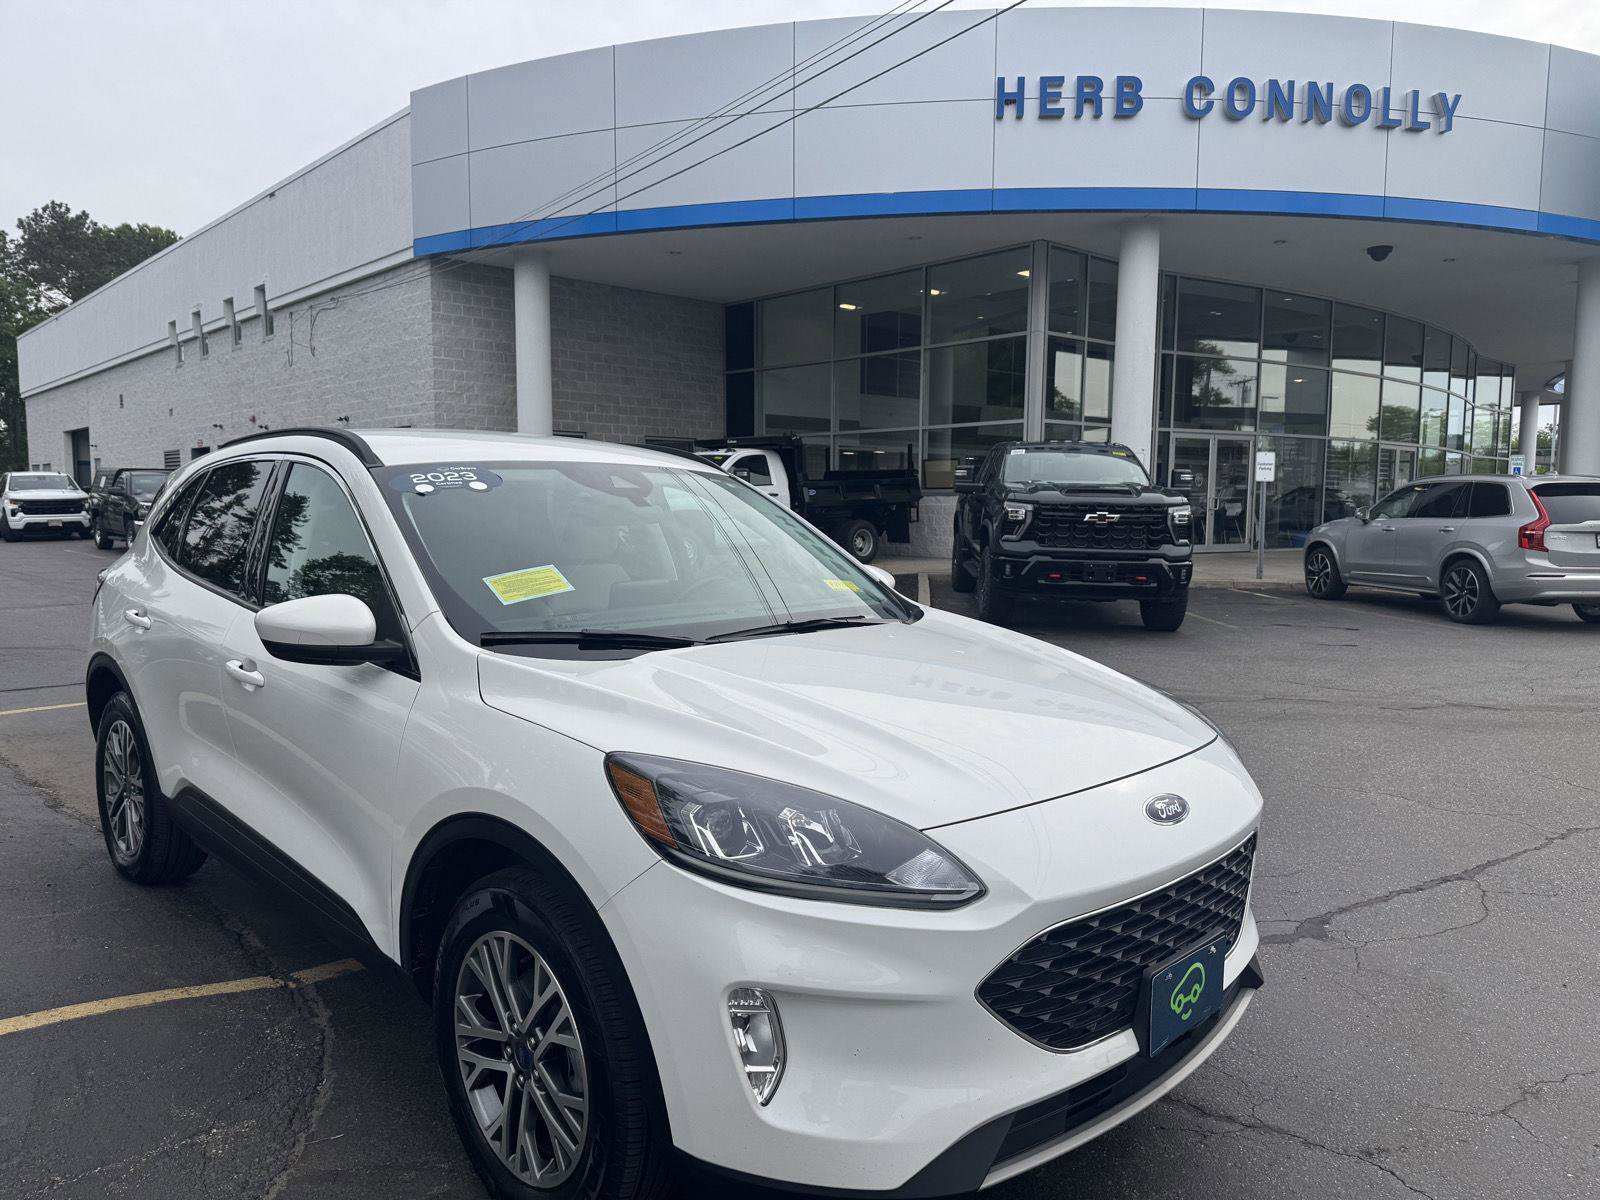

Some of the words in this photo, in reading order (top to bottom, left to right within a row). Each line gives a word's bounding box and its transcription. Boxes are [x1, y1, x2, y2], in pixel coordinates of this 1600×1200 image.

[995, 75, 1144, 119] HERB
[1182, 75, 1462, 134] CONNOLLY
[410, 471, 478, 484] 2023
[1154, 799, 1182, 819] Ford
